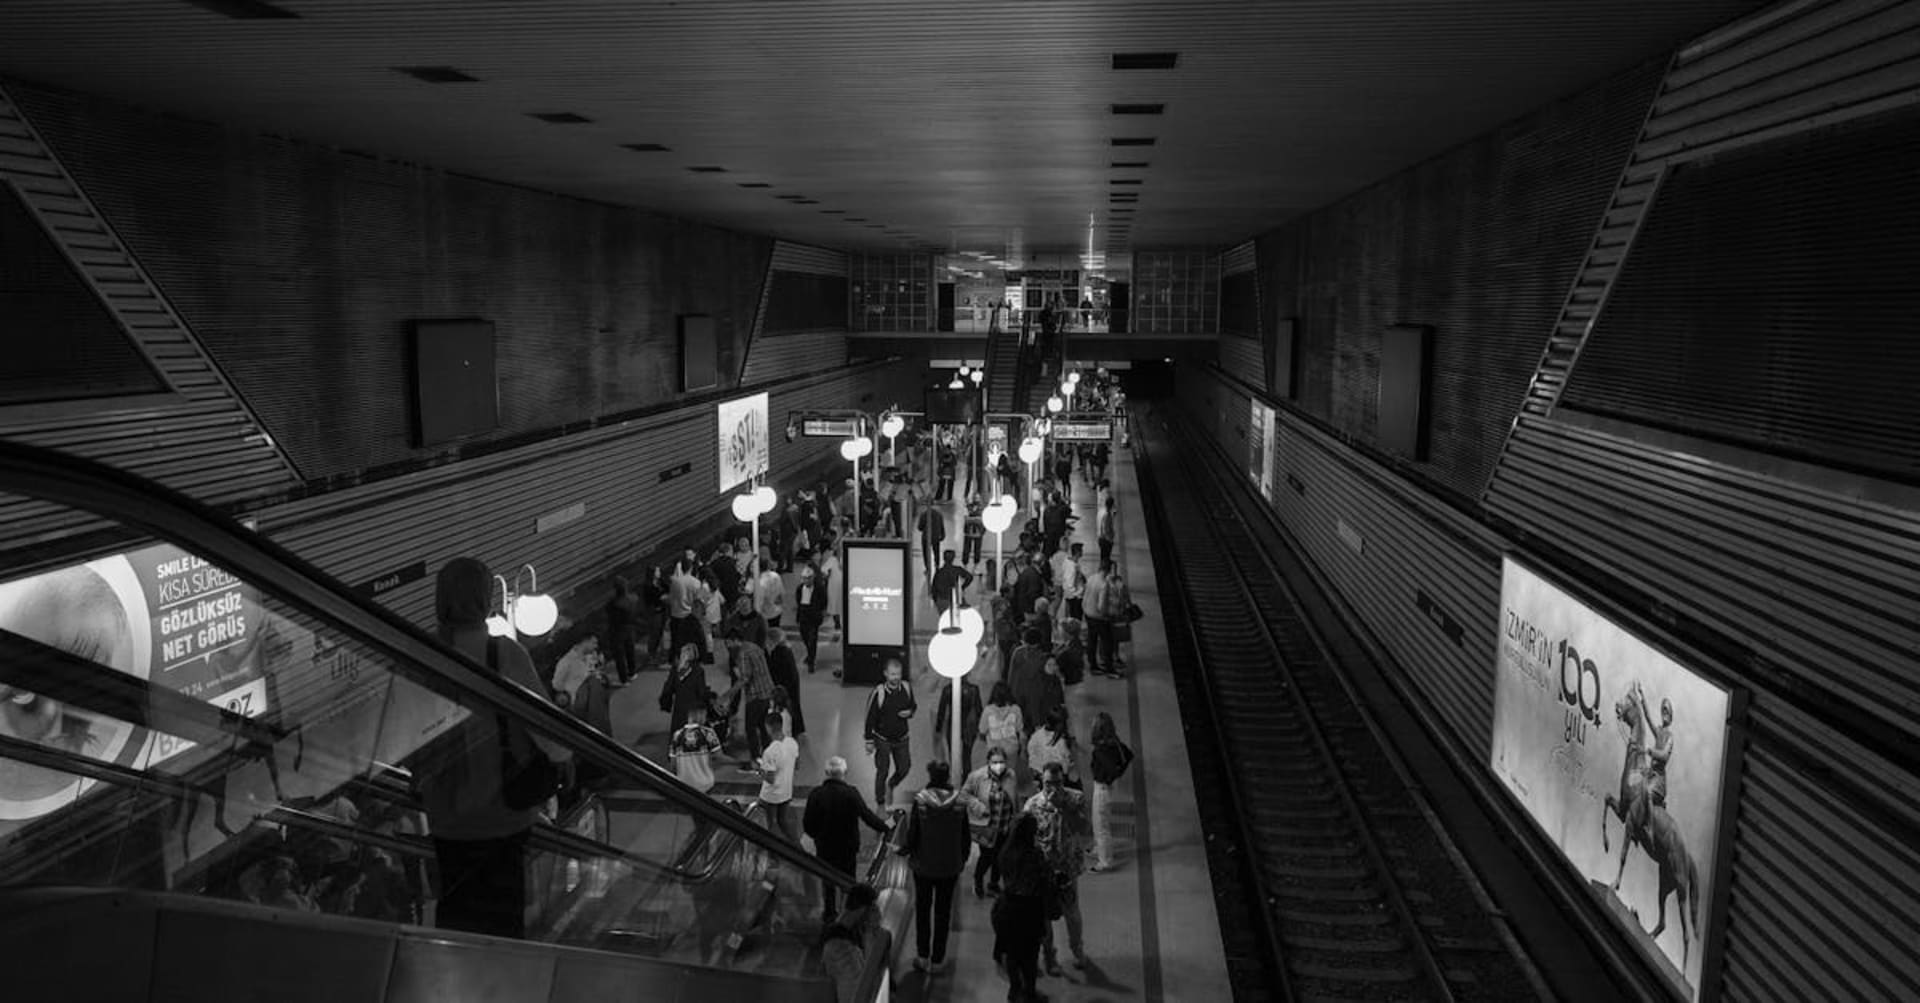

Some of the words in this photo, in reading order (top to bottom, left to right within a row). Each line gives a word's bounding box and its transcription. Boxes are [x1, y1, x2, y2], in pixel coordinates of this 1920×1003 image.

[157, 557, 189, 579] SMILE
[159, 577, 191, 604] KISA
[161, 591, 242, 635] GÖZLÜKSÜZ
[163, 633, 192, 662] NET
[198, 615, 245, 648] GÖRÜŞ
[1558, 638, 1601, 720] 100
